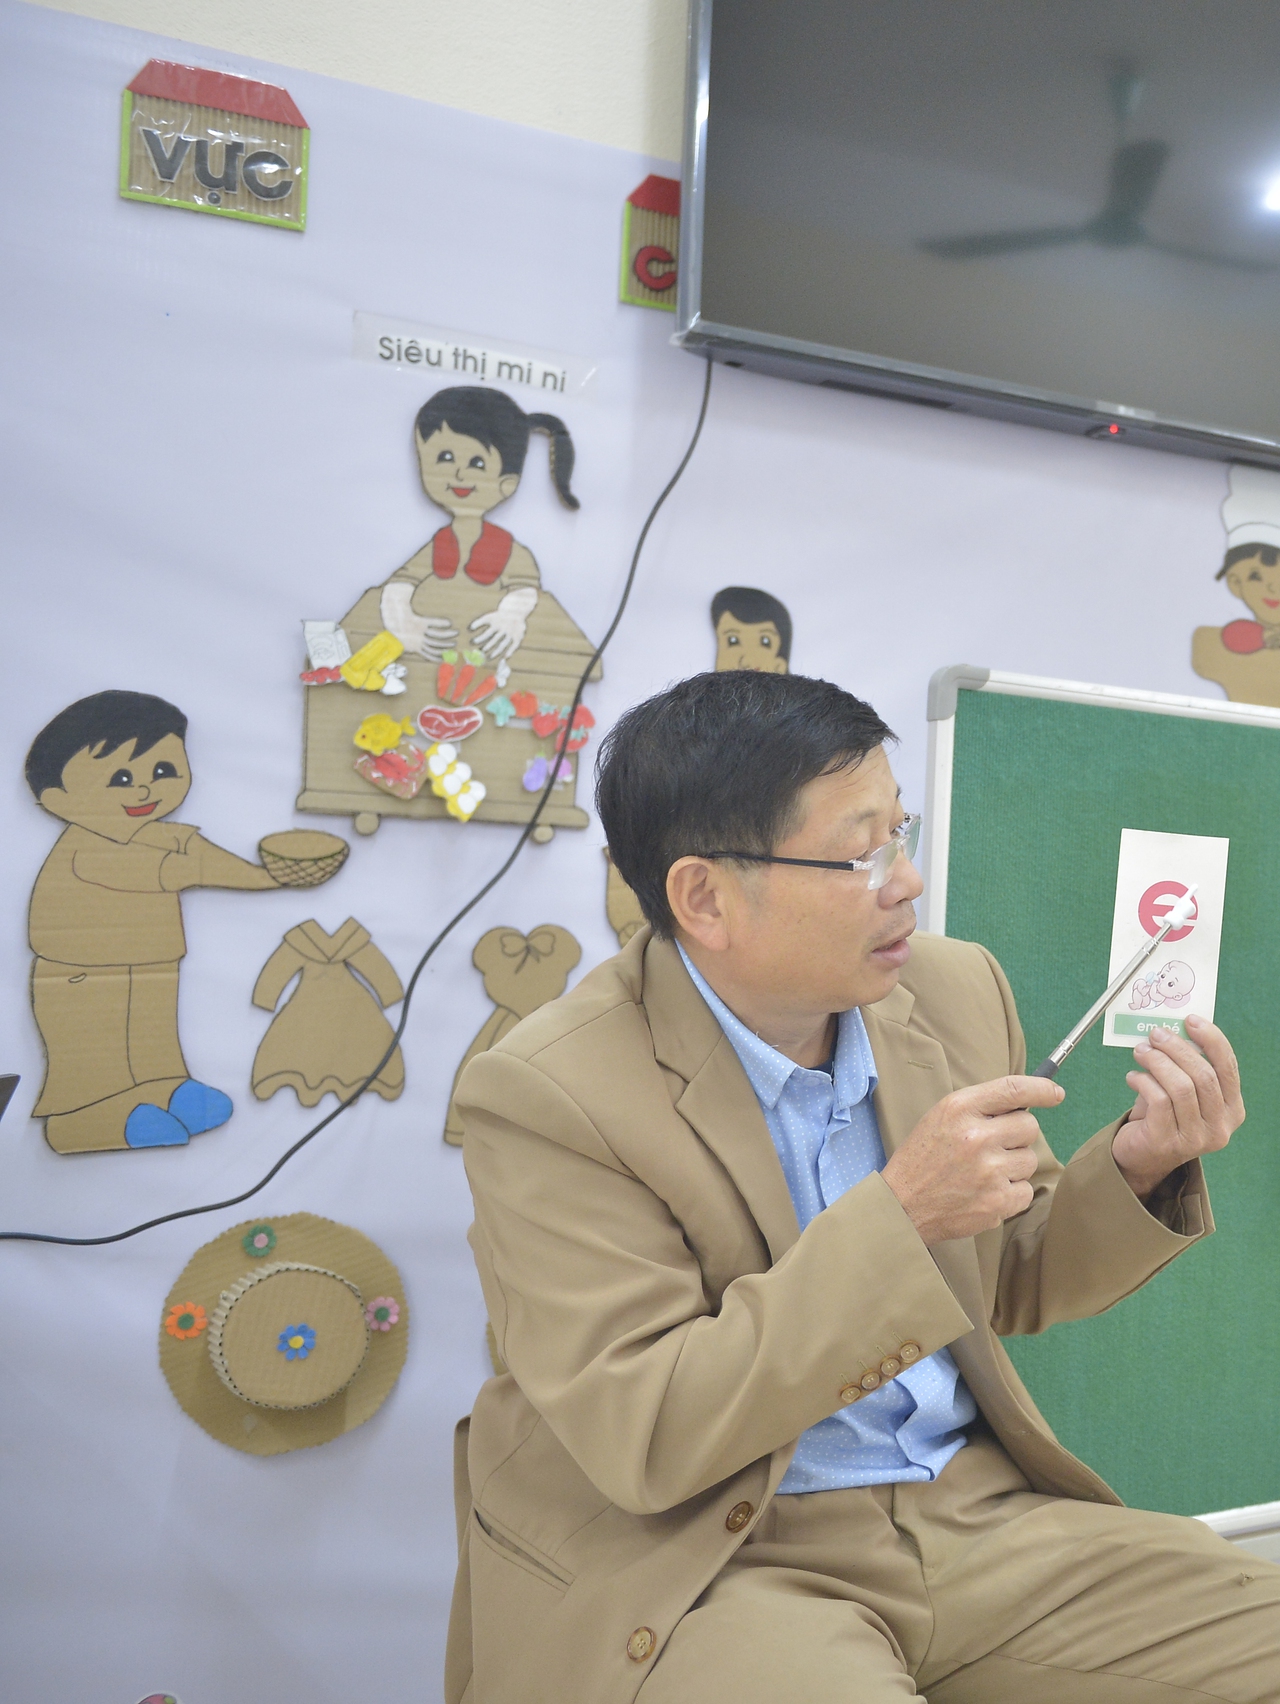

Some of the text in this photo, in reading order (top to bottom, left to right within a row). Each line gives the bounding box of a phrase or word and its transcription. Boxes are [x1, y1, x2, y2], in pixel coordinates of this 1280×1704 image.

[139, 126, 294, 206] vực
[379, 336, 566, 392] Siêu thị mi ni
[1138, 880, 1199, 942] e
